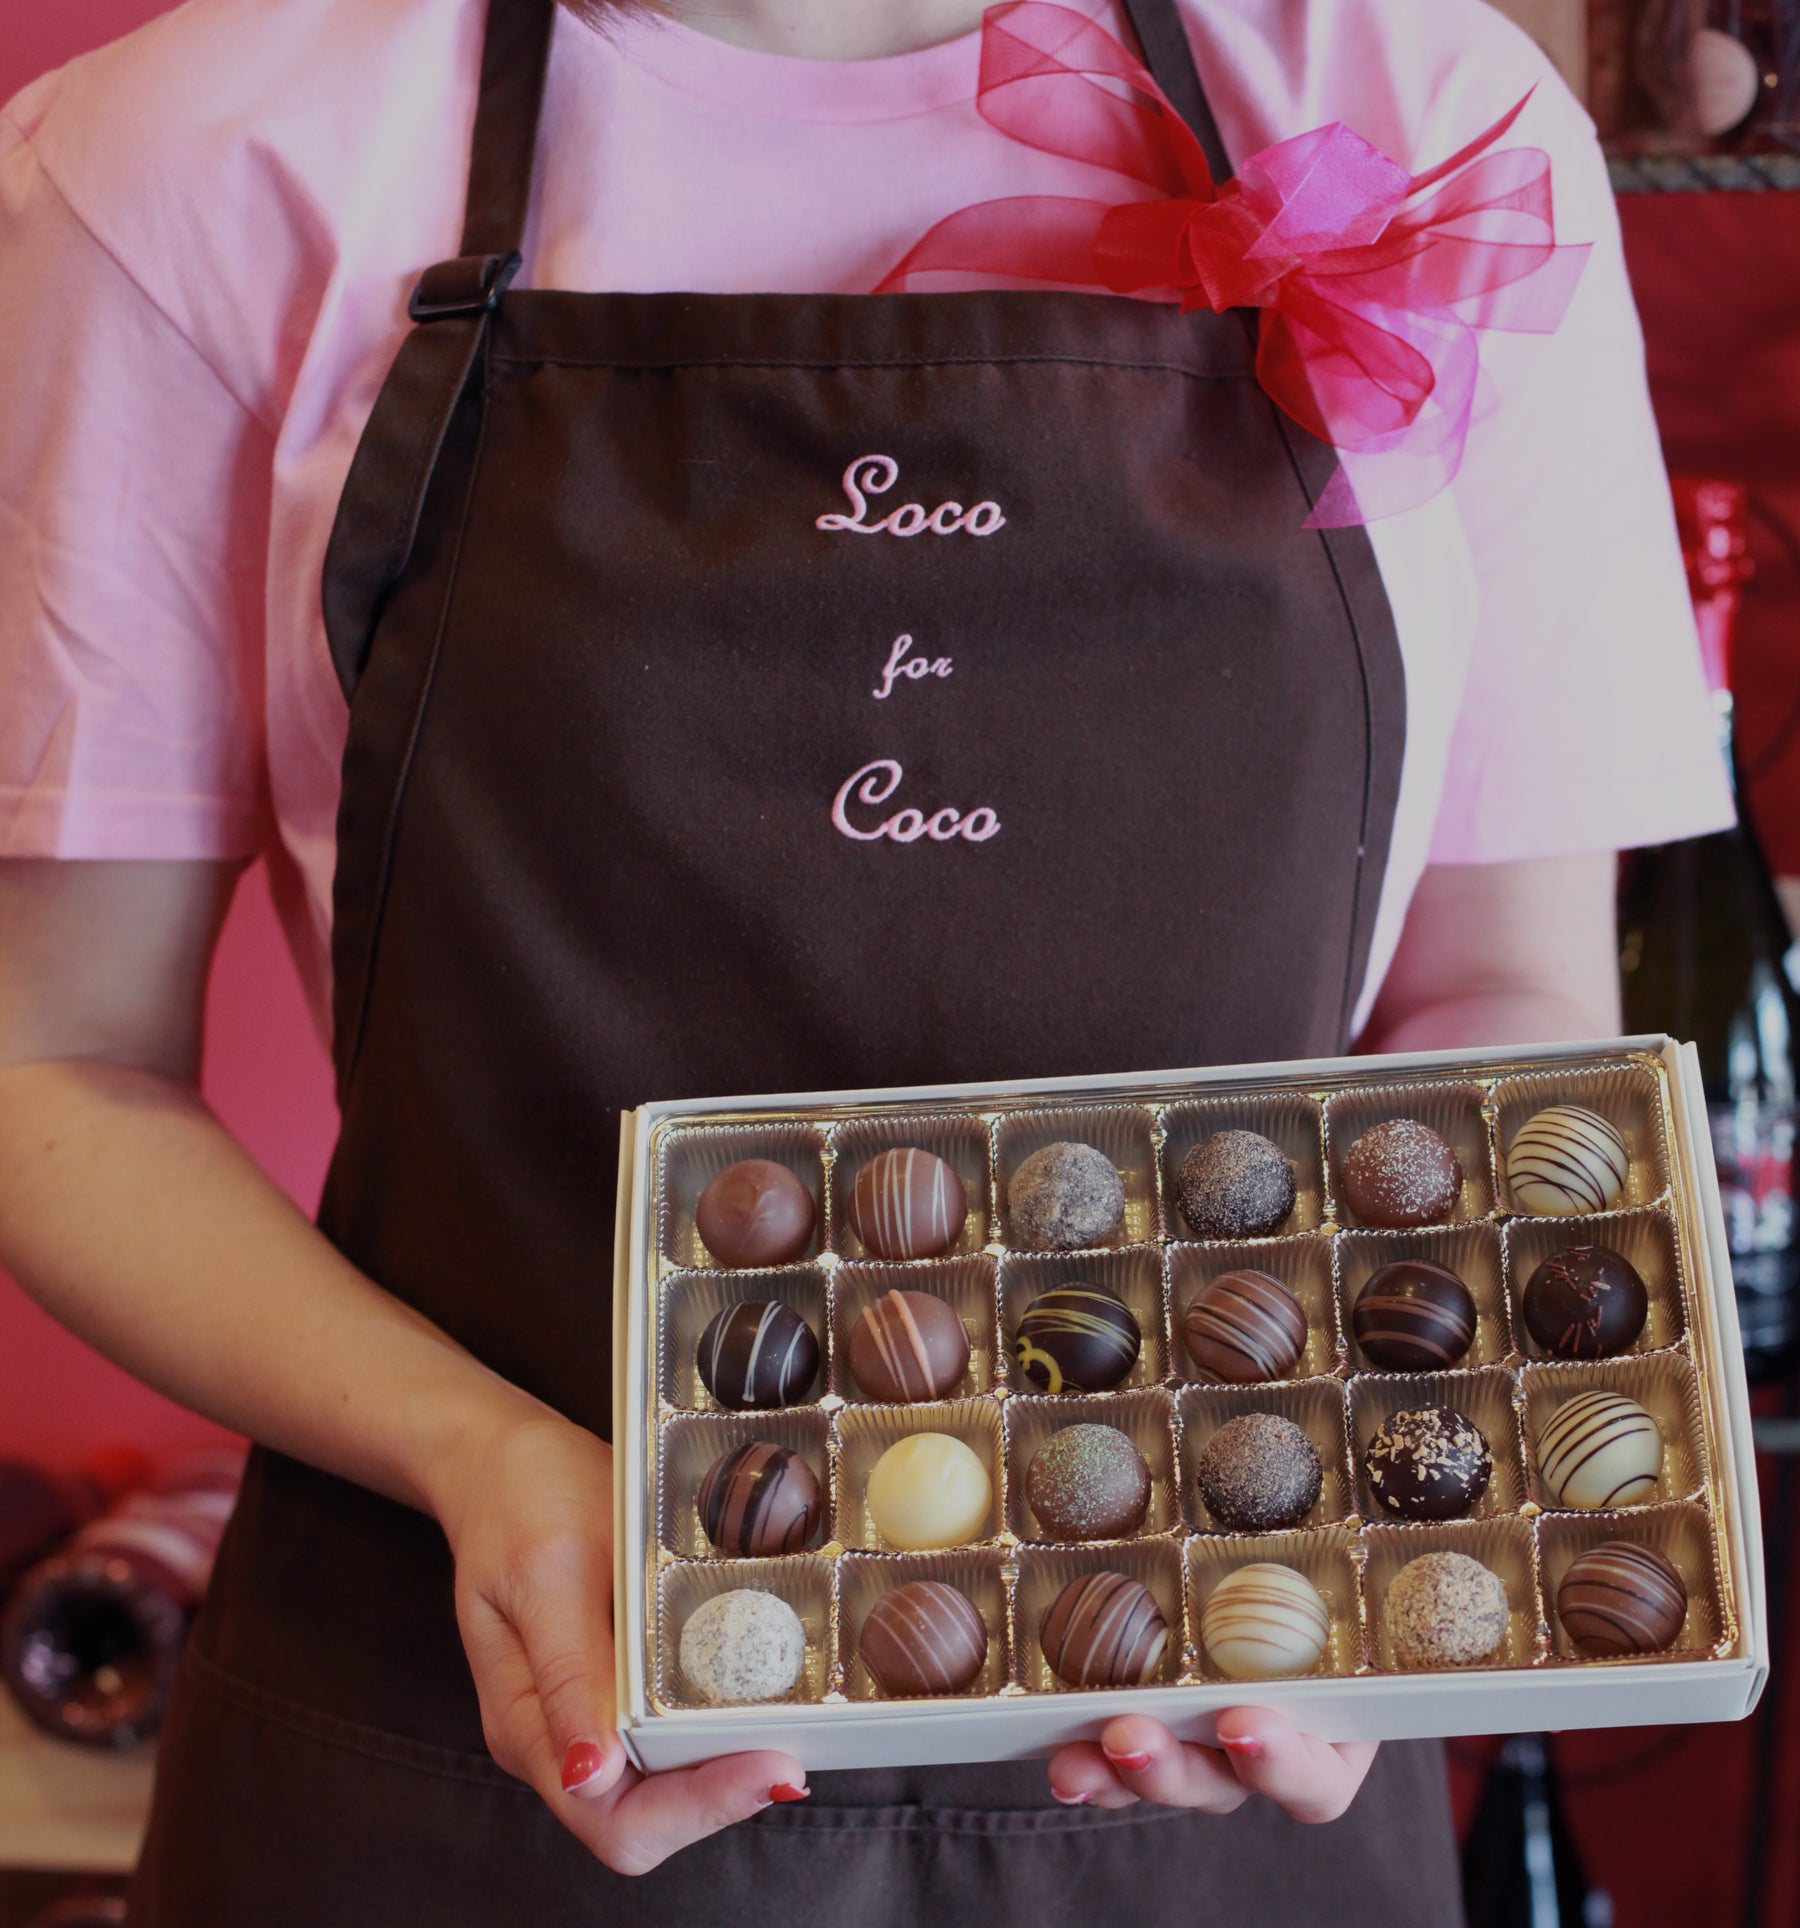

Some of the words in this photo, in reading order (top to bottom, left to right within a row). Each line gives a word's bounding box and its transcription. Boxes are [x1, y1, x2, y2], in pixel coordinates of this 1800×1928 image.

[816, 454, 1007, 537] Loco
[872, 634, 954, 699] for
[832, 759, 1001, 843] Coco
